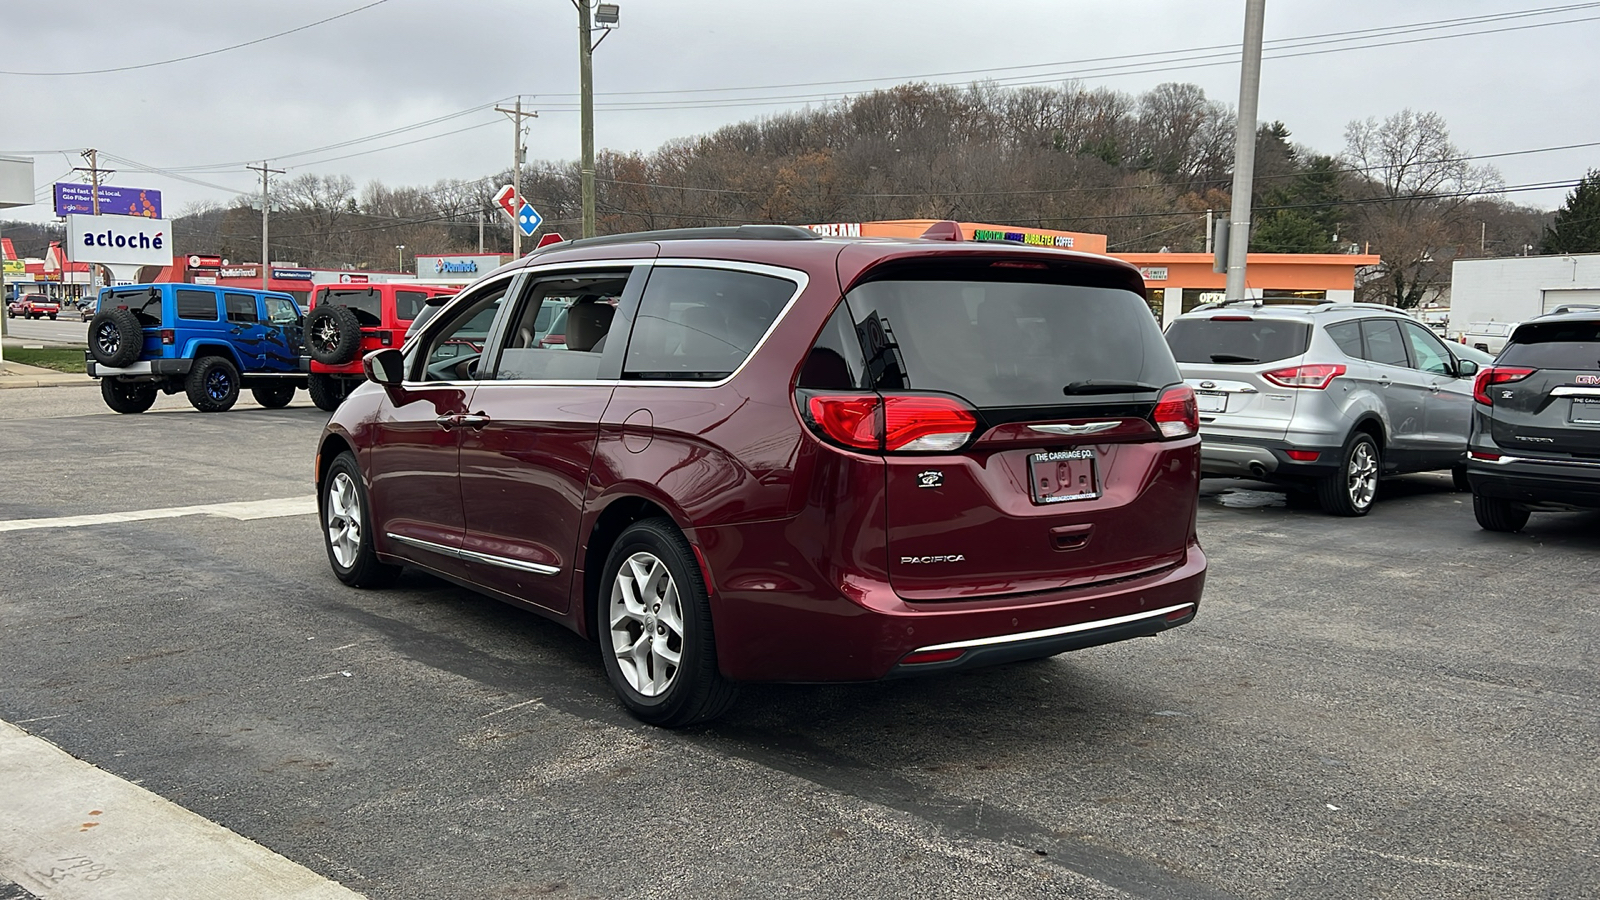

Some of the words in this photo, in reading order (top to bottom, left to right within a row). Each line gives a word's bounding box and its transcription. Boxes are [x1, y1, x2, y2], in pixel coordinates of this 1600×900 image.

[813, 223, 861, 237] CREAM
[84, 230, 163, 249] acloché
[1055, 236, 1074, 247] COFFEE
[443, 261, 477, 273] Domino's
[1199, 292, 1226, 303] OPEN
[1035, 453, 1048, 461] THE
[1049, 451, 1081, 460] CARRIAGE
[1082, 450, 1093, 459] CO.
[901, 554, 966, 565] PACIFICA
